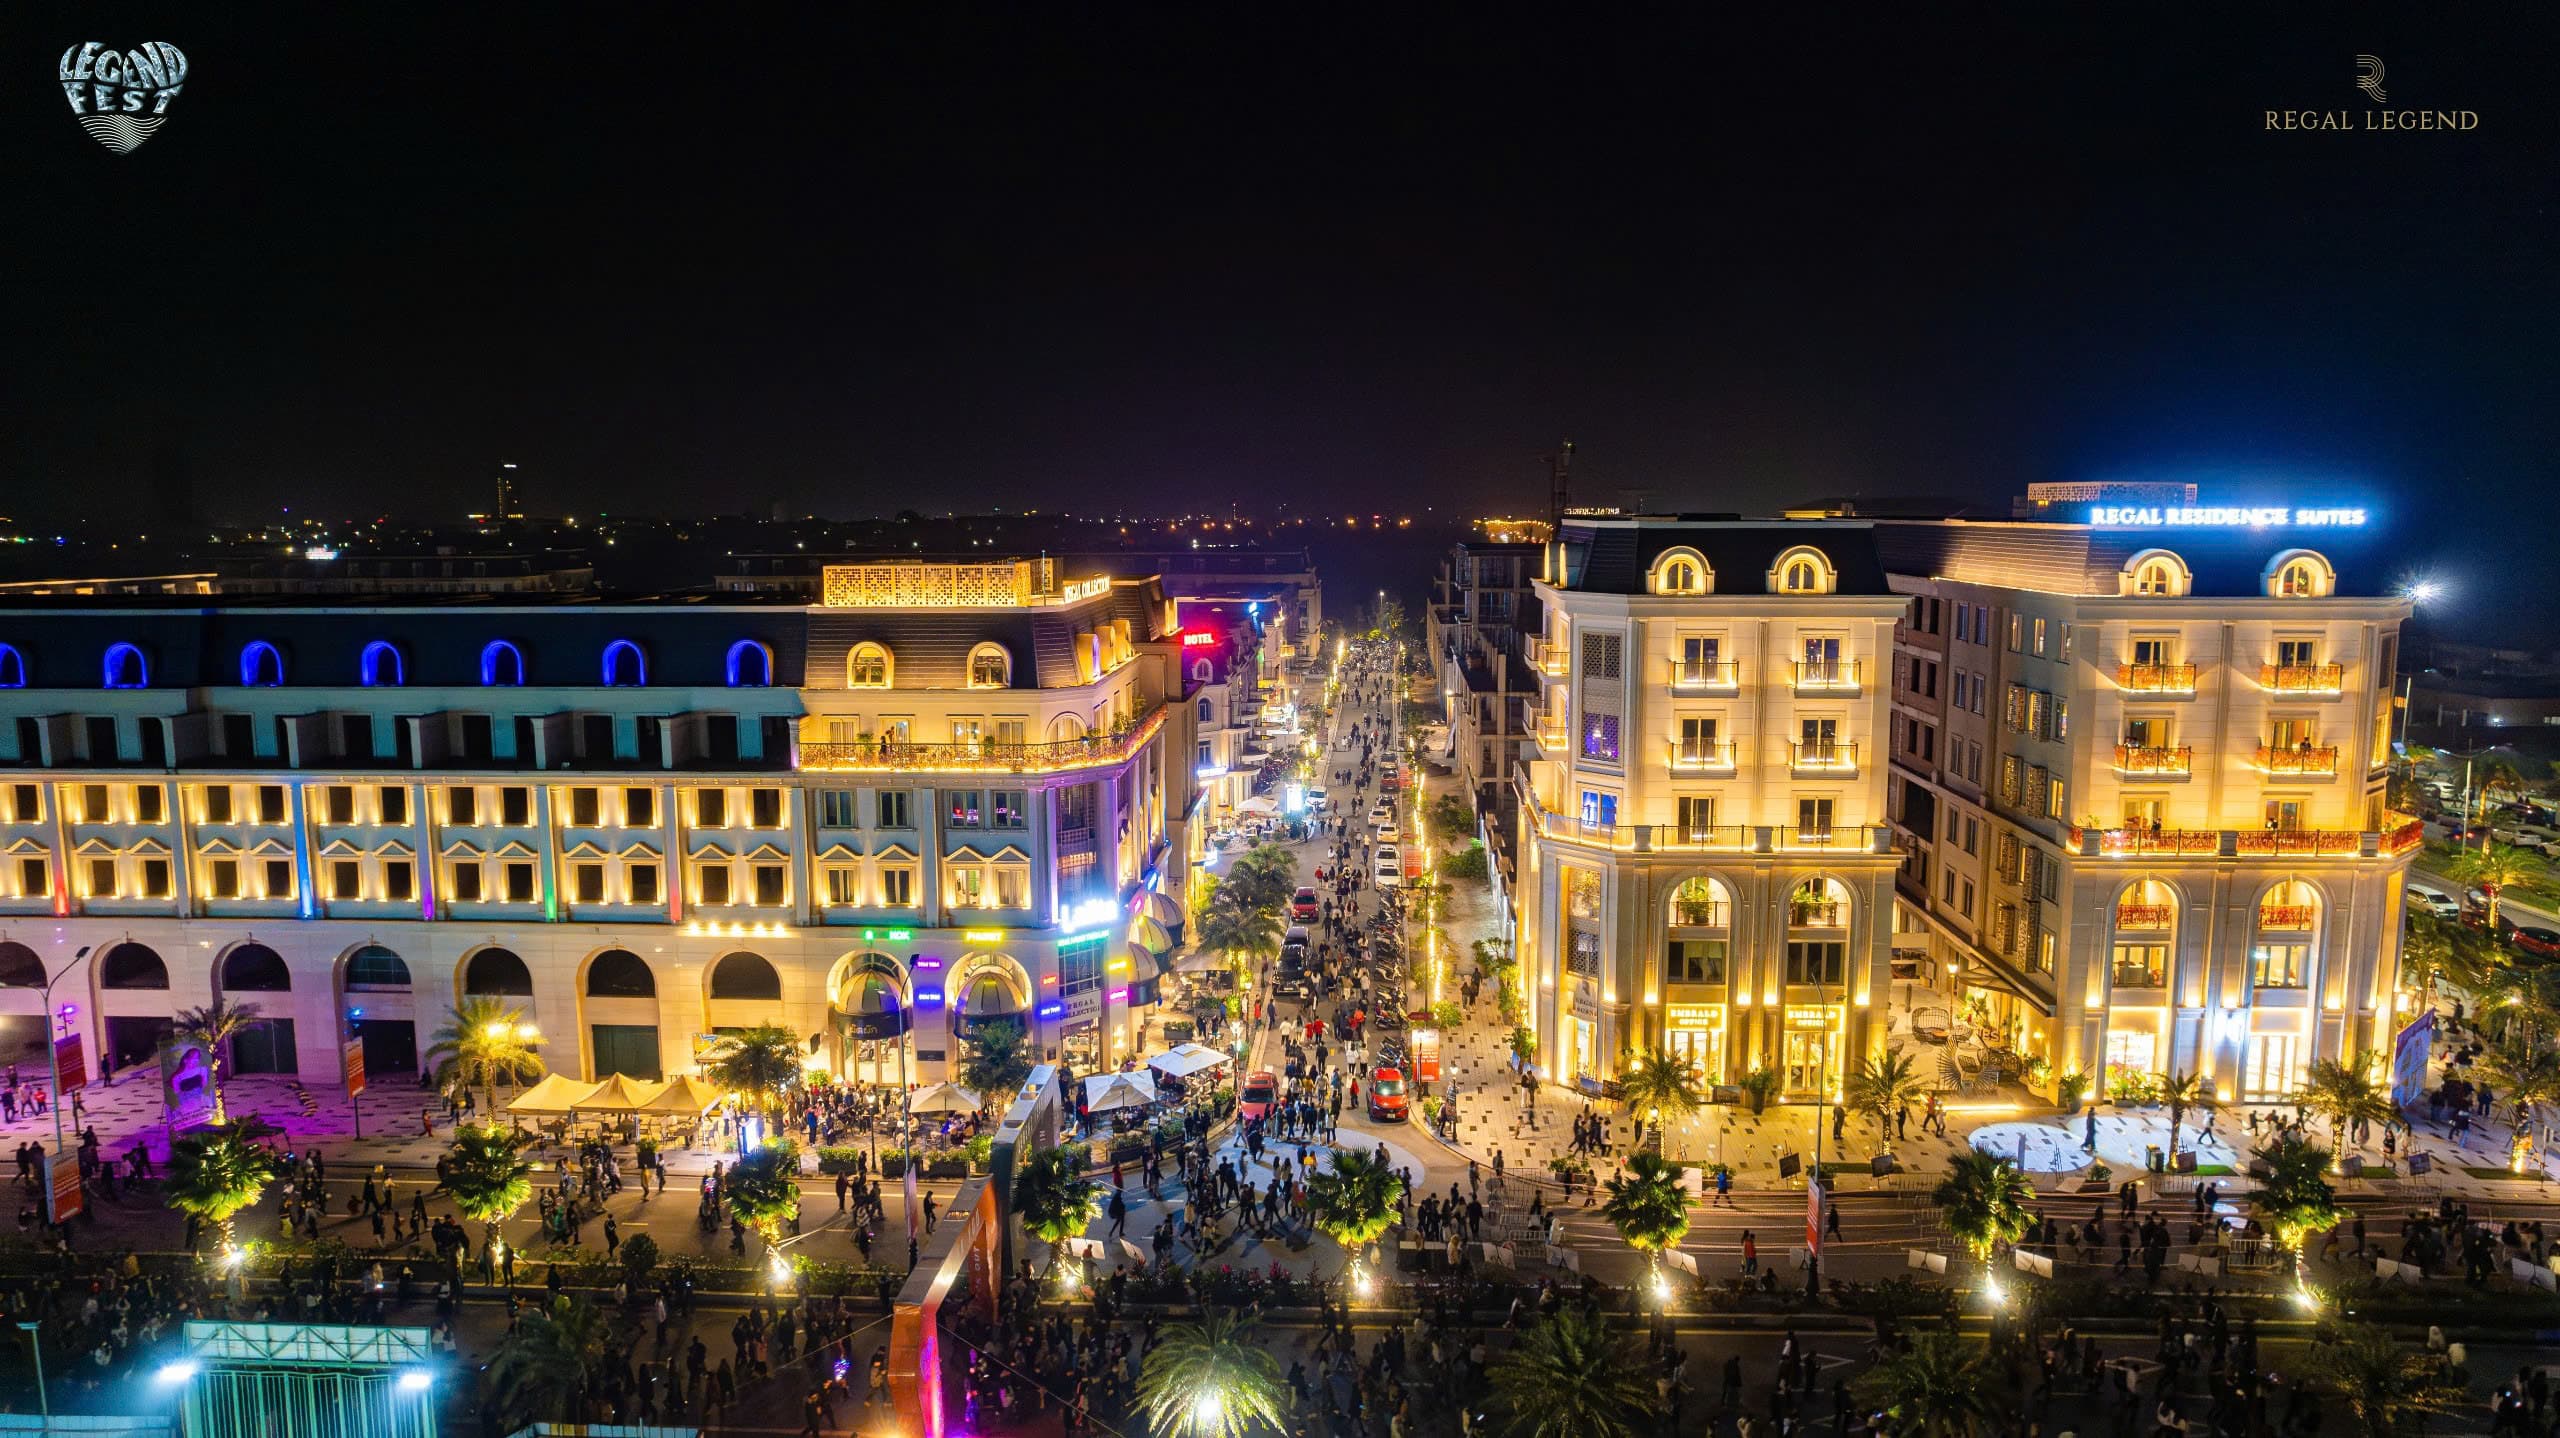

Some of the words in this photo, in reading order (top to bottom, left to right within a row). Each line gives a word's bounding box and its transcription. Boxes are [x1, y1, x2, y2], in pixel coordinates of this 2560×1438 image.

[2091, 507, 2163, 525] REGAL
[2166, 507, 2290, 525] RESIDENCE
[2295, 509, 2366, 525] SUITES
[1183, 633, 1214, 646] HOTEL
[1670, 1009, 1718, 1018] EMERALD
[973, 1245, 981, 1271] OUT
